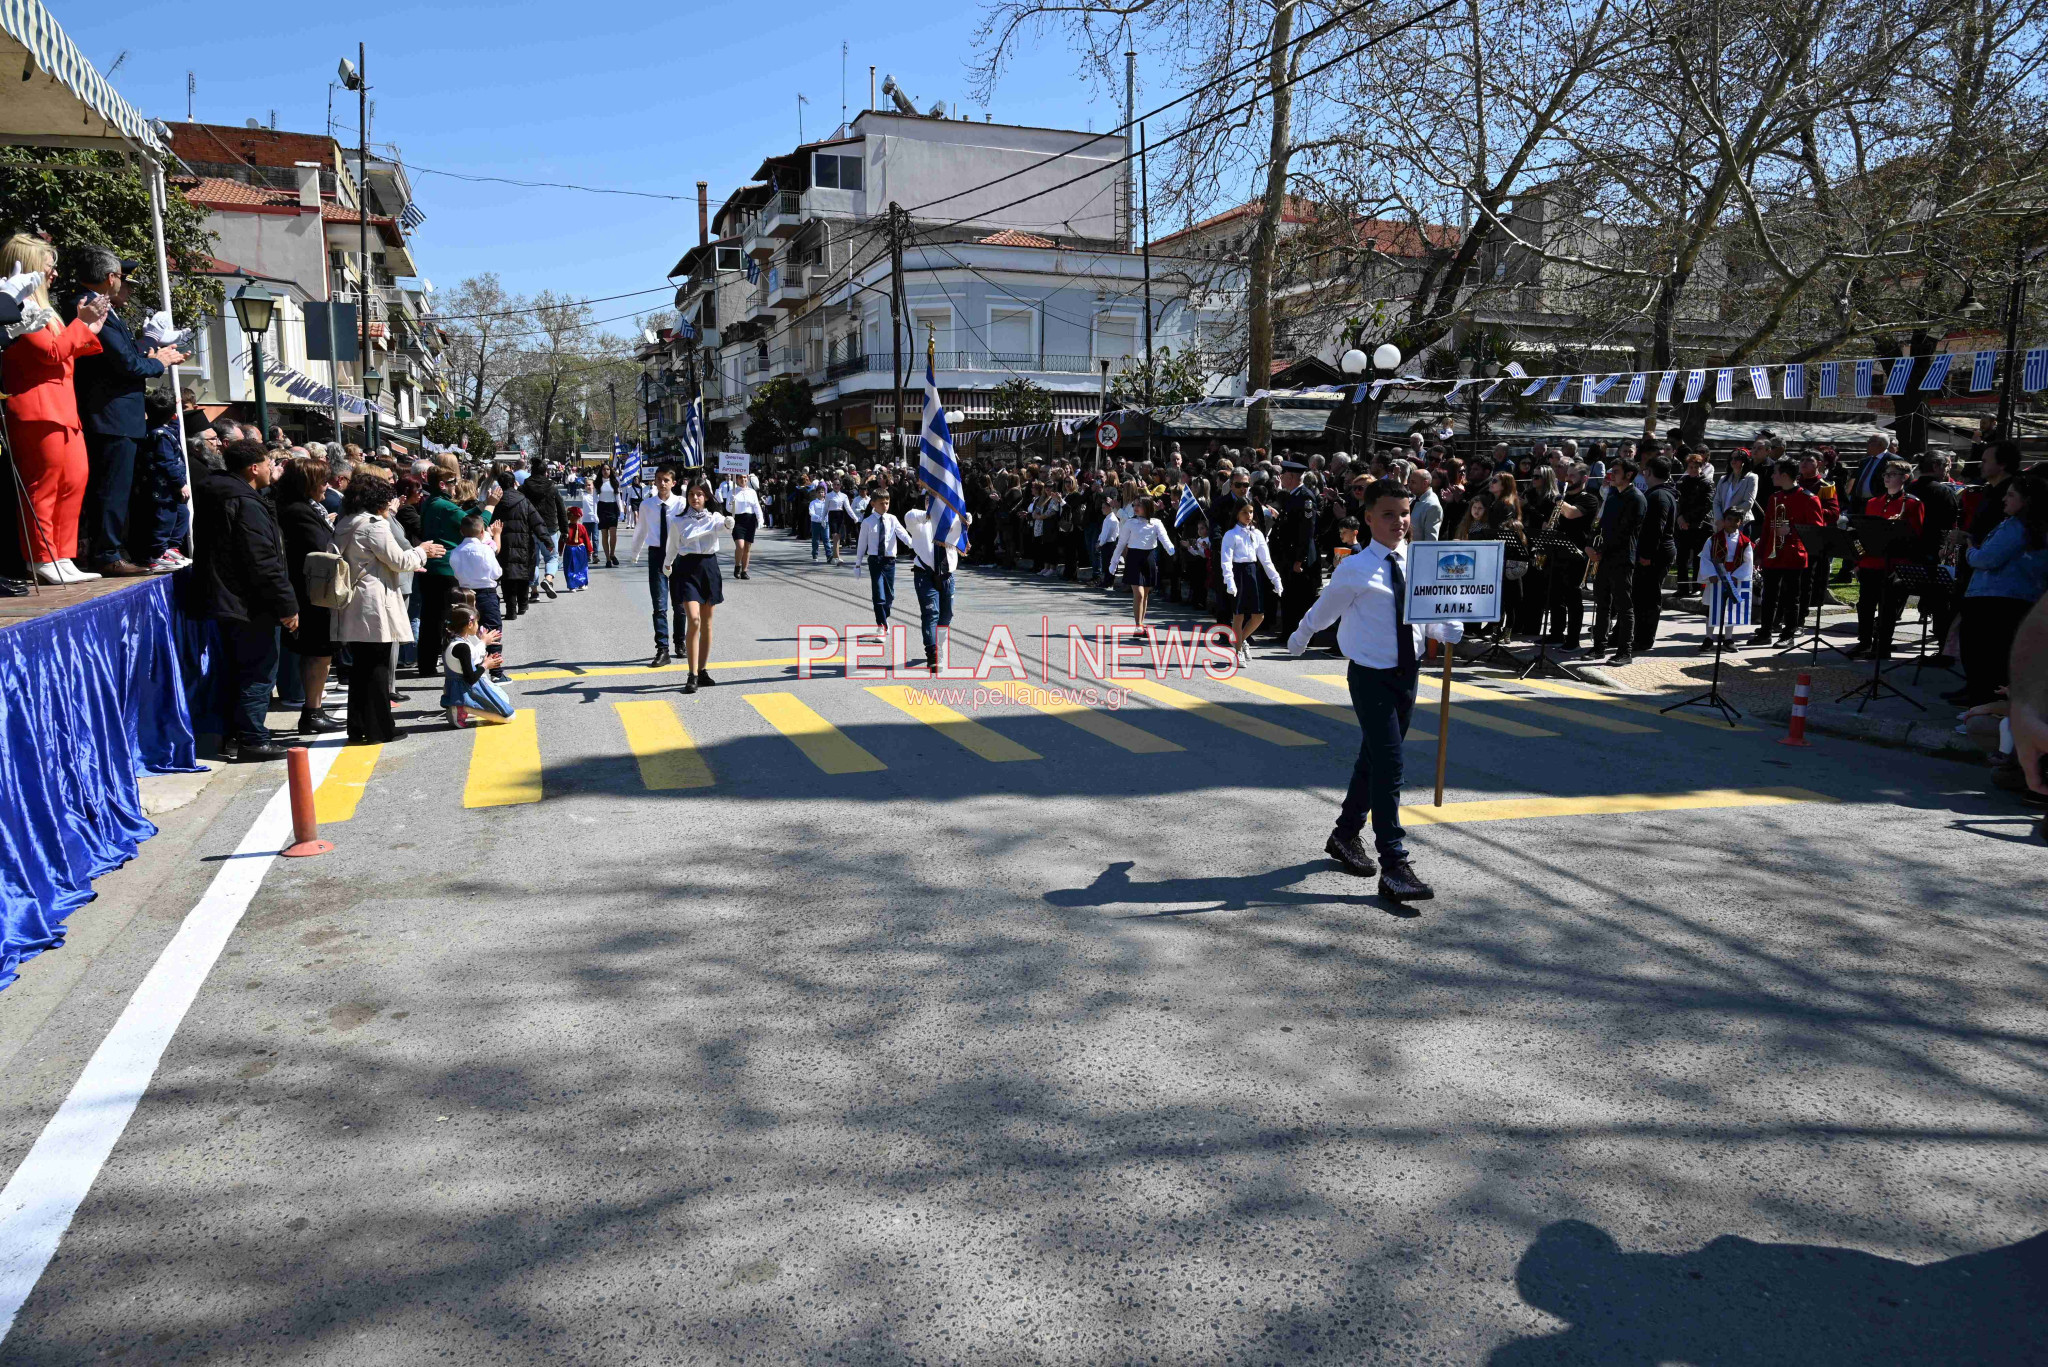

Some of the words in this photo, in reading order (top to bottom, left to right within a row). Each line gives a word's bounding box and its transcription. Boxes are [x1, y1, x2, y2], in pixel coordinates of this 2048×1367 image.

[1414, 585, 1458, 596] ΔΗΜΟΤΙΚΟ
[1460, 584, 1494, 595] ΣΧΟΛΕΙΟ
[1435, 603, 1473, 614] ΚΑΛΗΣ
